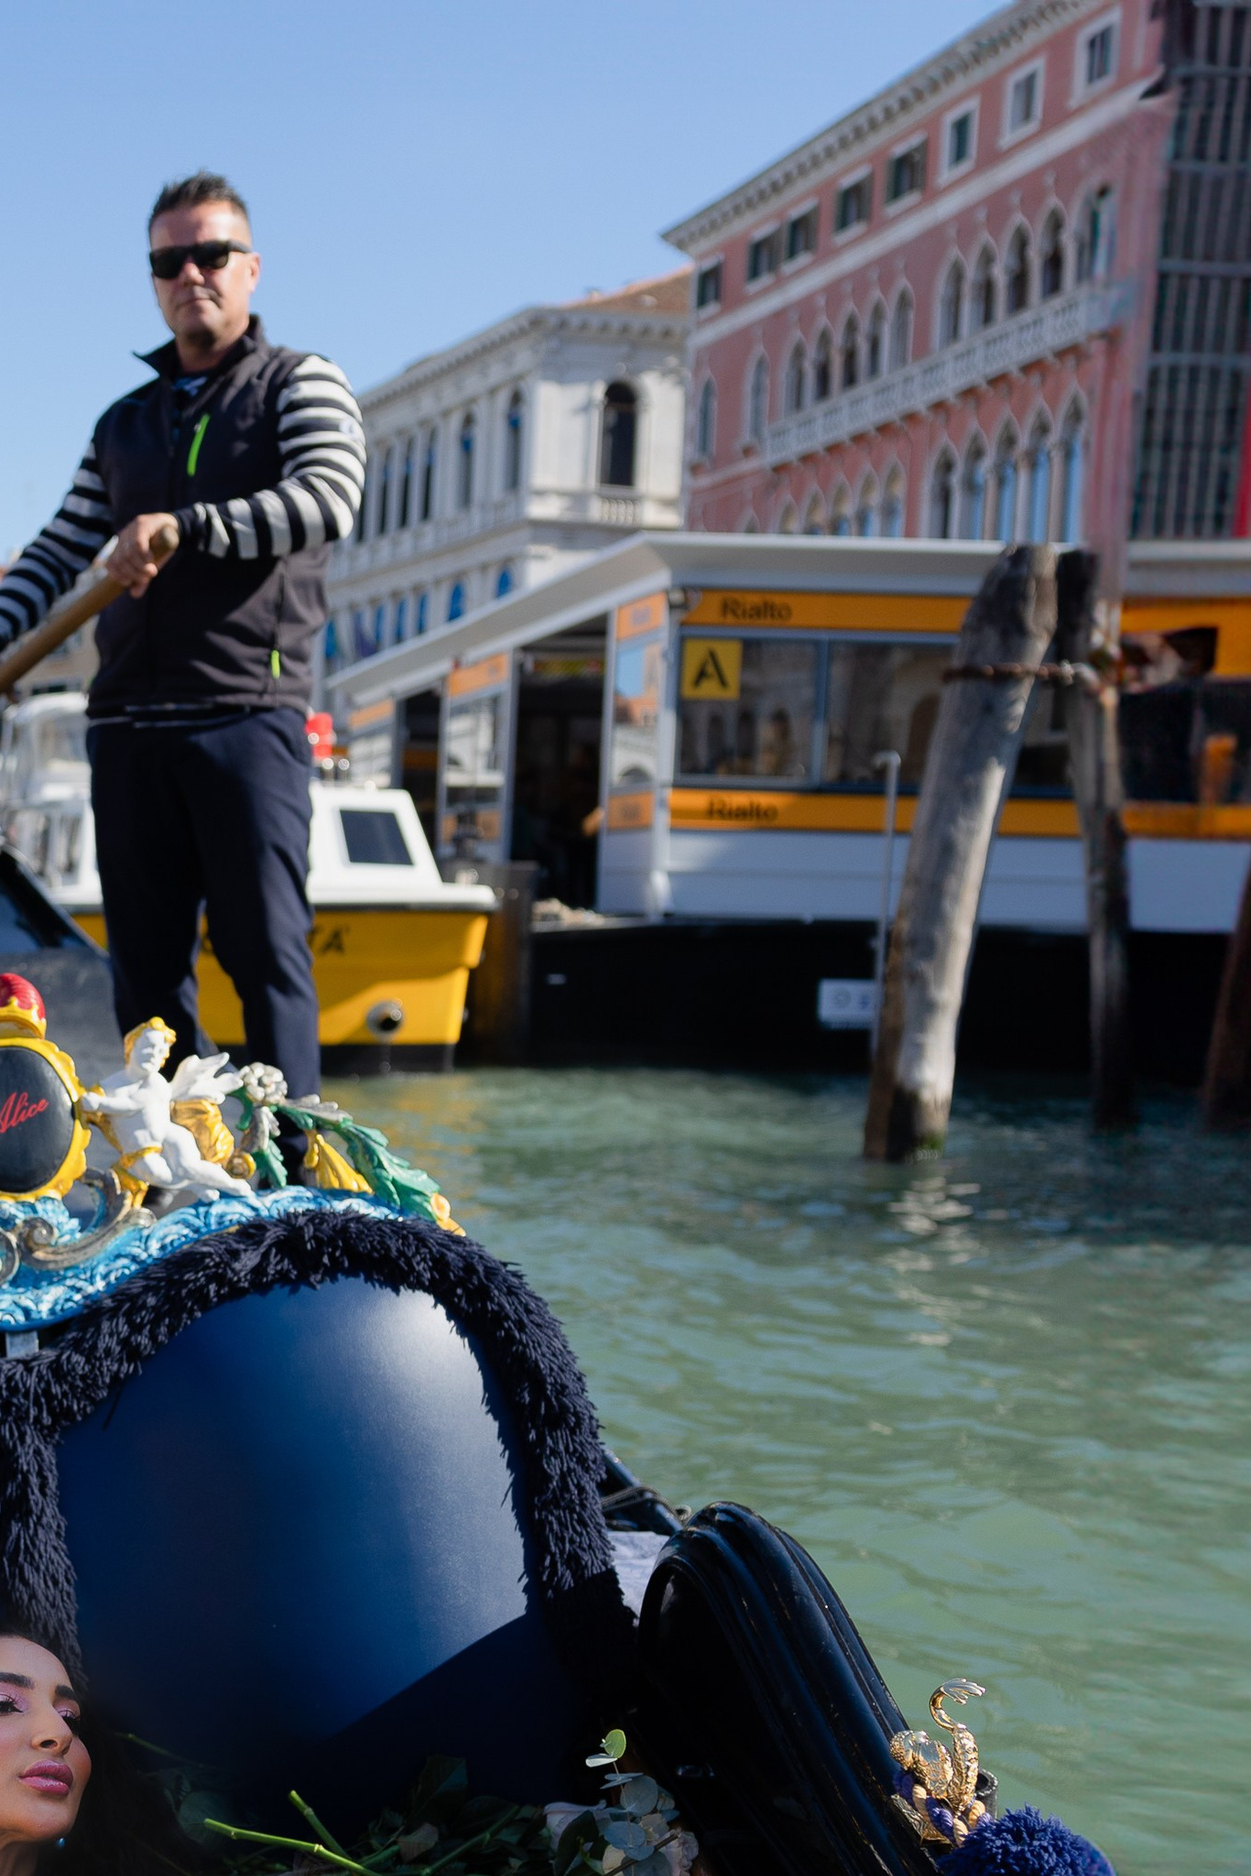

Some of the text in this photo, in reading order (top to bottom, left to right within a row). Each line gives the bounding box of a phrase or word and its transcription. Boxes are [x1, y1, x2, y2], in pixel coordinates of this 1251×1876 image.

[721, 597, 792, 621] Rialto
[692, 649, 729, 688] A
[706, 797, 778, 821] Rialto
